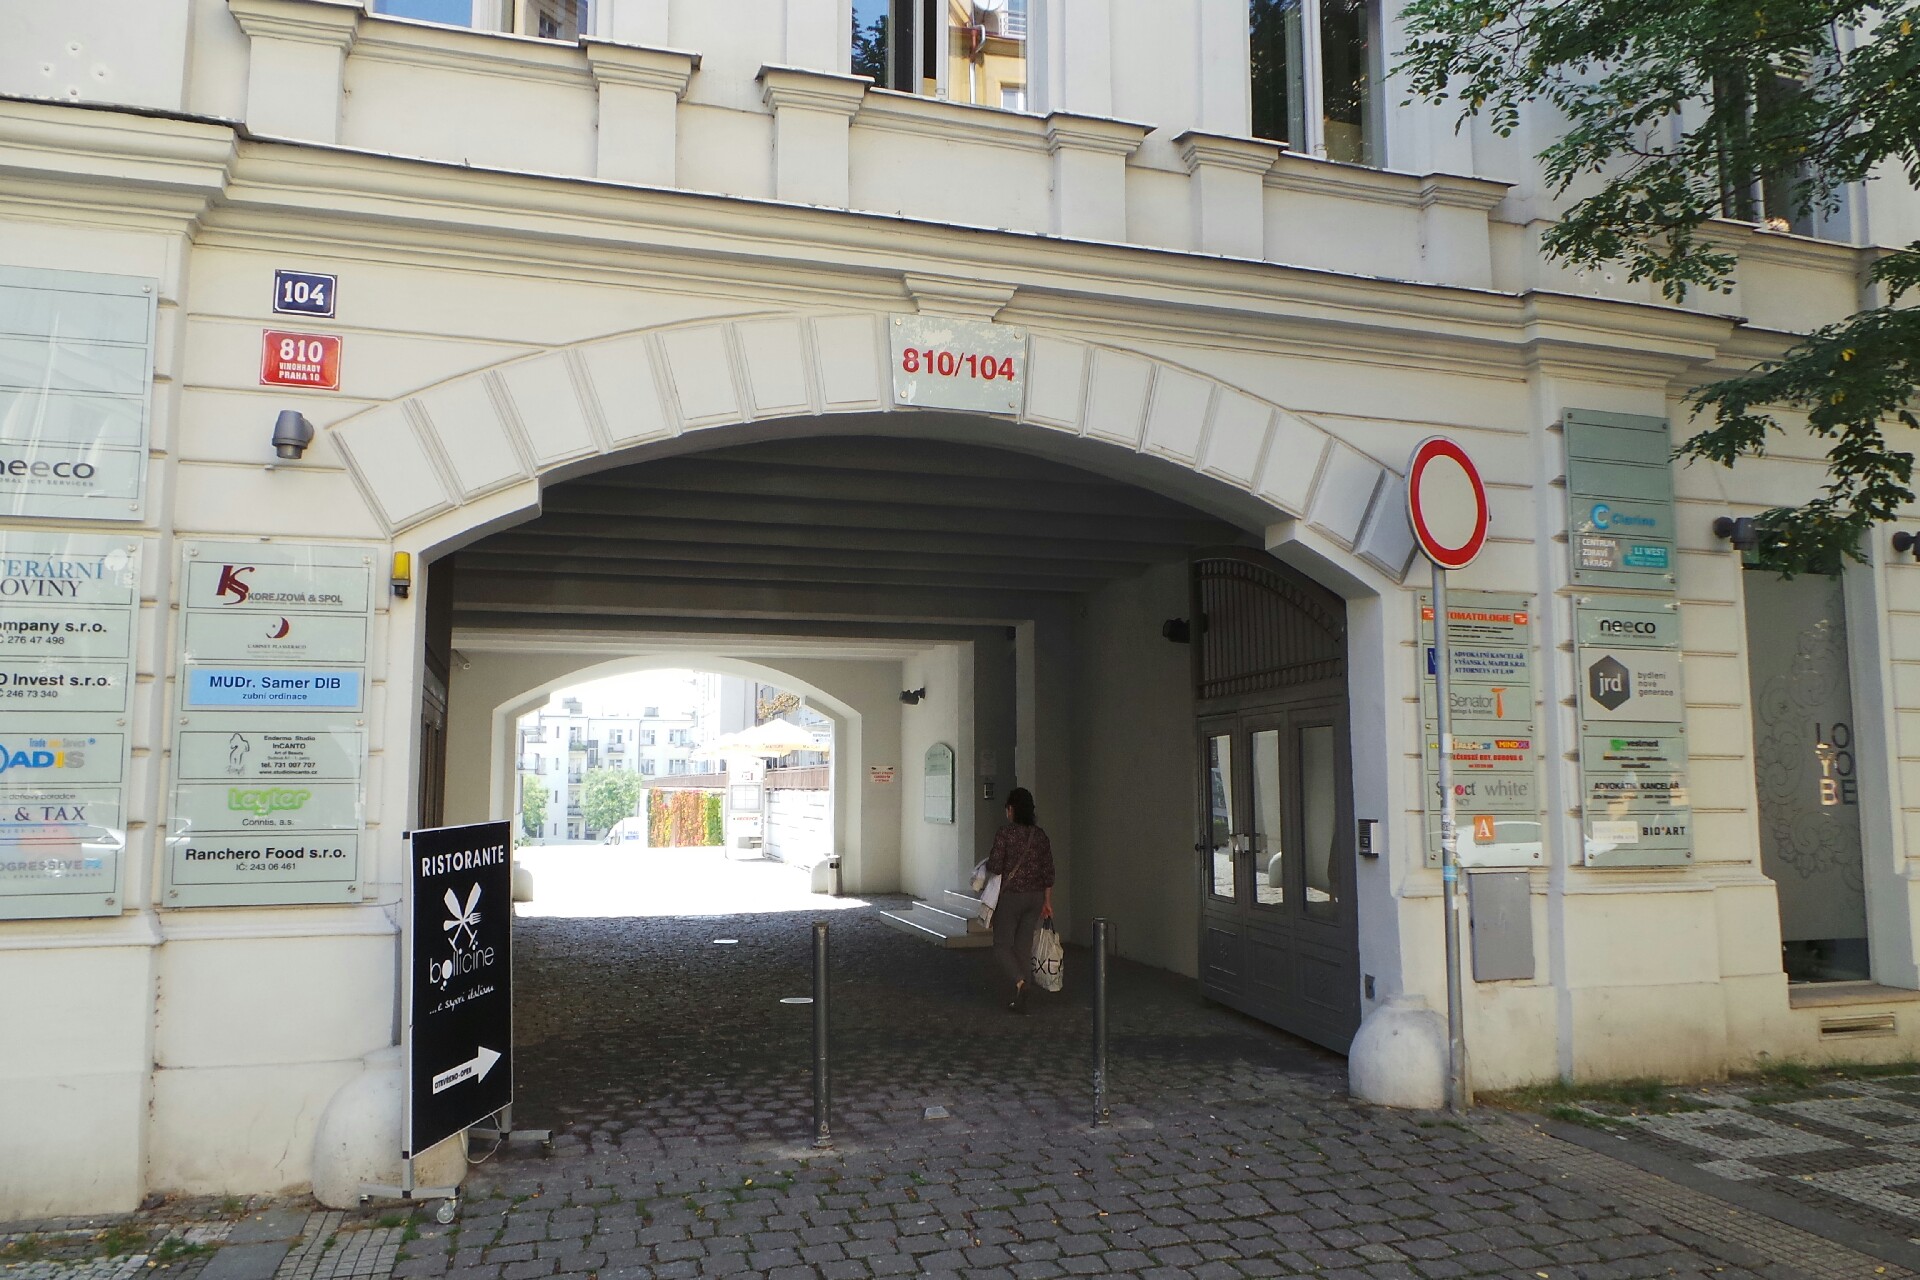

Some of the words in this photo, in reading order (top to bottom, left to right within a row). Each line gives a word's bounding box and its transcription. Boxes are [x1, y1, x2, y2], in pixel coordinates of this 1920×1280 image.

[284, 280, 324, 306] 104
[280, 338, 323, 363] 810
[279, 362, 321, 373] VINOHRADY
[902, 347, 1015, 382] 810/104
[279, 370, 308, 380] PRAHA
[310, 372, 320, 381] 10
[247, 591, 306, 602] KOREJZOVÁ
[307, 594, 317, 602] &
[318, 594, 344, 604] SPOL
[1447, 610, 1512, 623] OMATOLOGIE
[0, 621, 60, 634] mpany
[65, 622, 107, 633] s.r.o.
[1599, 619, 1656, 634] neeco
[7, 635, 27, 644] 276
[29, 636, 42, 644] 47
[45, 636, 65, 645] 498
[13, 673, 64, 686] Invest
[69, 676, 111, 687] s.r.o.
[209, 675, 256, 689] MUDr.
[261, 676, 310, 689] Samer
[314, 677, 341, 689] DIB
[1598, 672, 1623, 697] jrd
[6, 689, 24, 698] 246
[27, 690, 39, 698] 73
[40, 690, 58, 699] 340
[242, 692, 267, 700] zubní
[268, 693, 308, 701] ordinace
[1448, 692, 1494, 708] Senator
[272, 742, 306, 750] InCANTO
[1499, 740, 1530, 749] MINDOK
[8, 750, 85, 769] ADIS
[1485, 779, 1528, 796] white
[14, 806, 31, 821] &
[40, 806, 86, 821] TAX
[1477, 818, 1492, 837] A
[185, 848, 261, 860] Ranchero
[265, 847, 304, 859] Food
[309, 849, 347, 859] s.r.o.
[421, 844, 504, 877] RISTORANTE
[250, 863, 266, 871] 243
[268, 863, 279, 871] 06
[429, 945, 495, 985] bollicine
